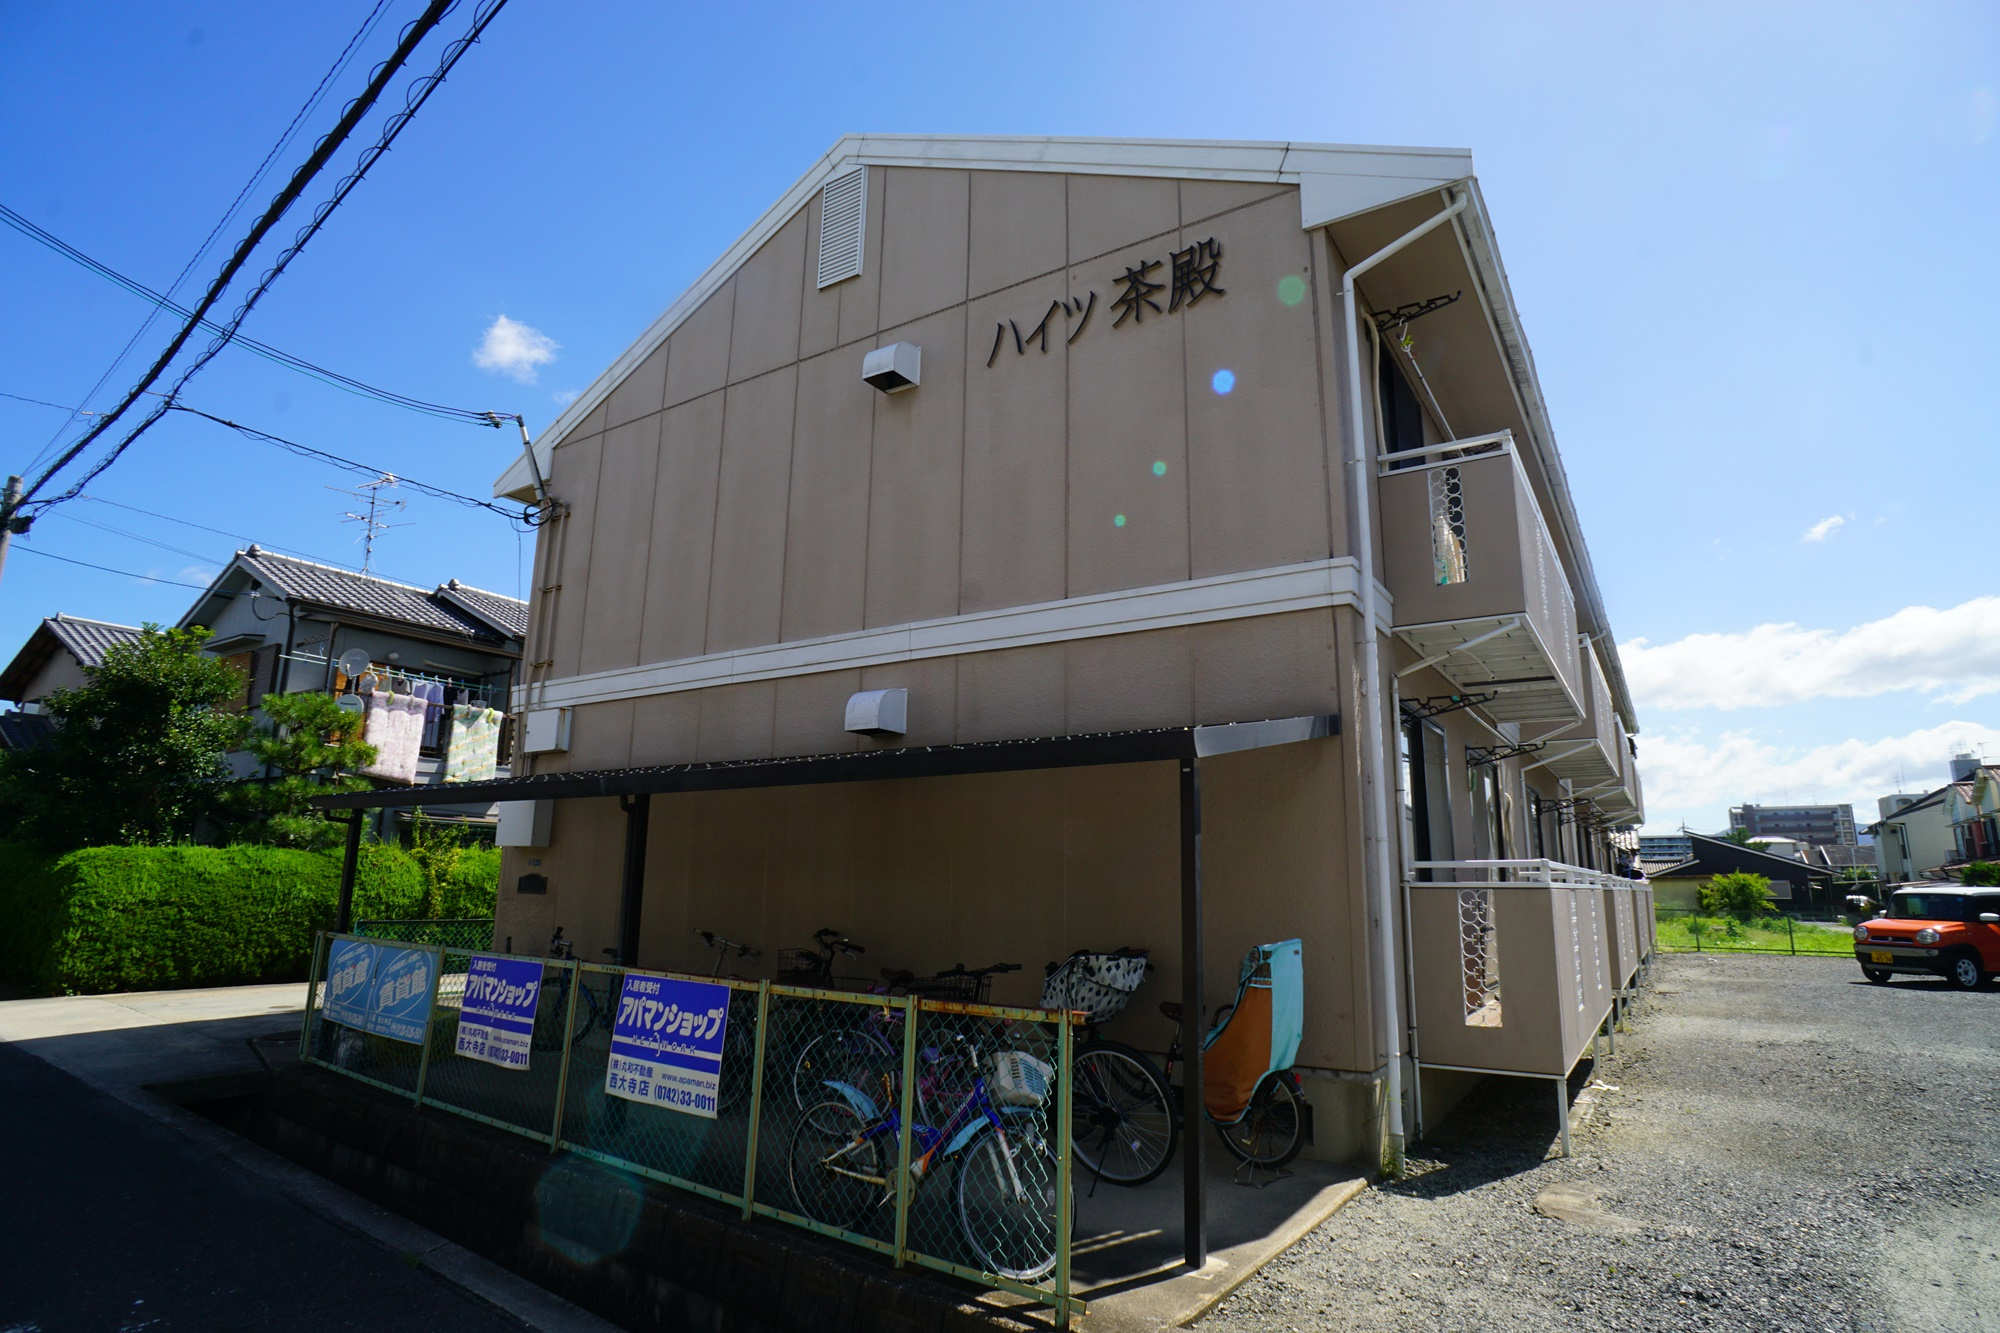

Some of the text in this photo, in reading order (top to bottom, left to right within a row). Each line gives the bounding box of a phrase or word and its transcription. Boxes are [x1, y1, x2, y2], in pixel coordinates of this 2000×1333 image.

[466, 974, 538, 1007] アパマンショップ
[626, 979, 660, 995] 入居者受付
[618, 996, 724, 1040] アパマンショップ
[458, 1037, 486, 1055] 西大寺店
[487, 1044, 528, 1065] (0742)33-0011
[610, 1059, 653, 1079] (株)丸和不動産
[609, 1072, 650, 1097] 西大寺店
[661, 1072, 716, 1090] www.apaman.biz
[654, 1083, 715, 1112] (0742)33-0011
